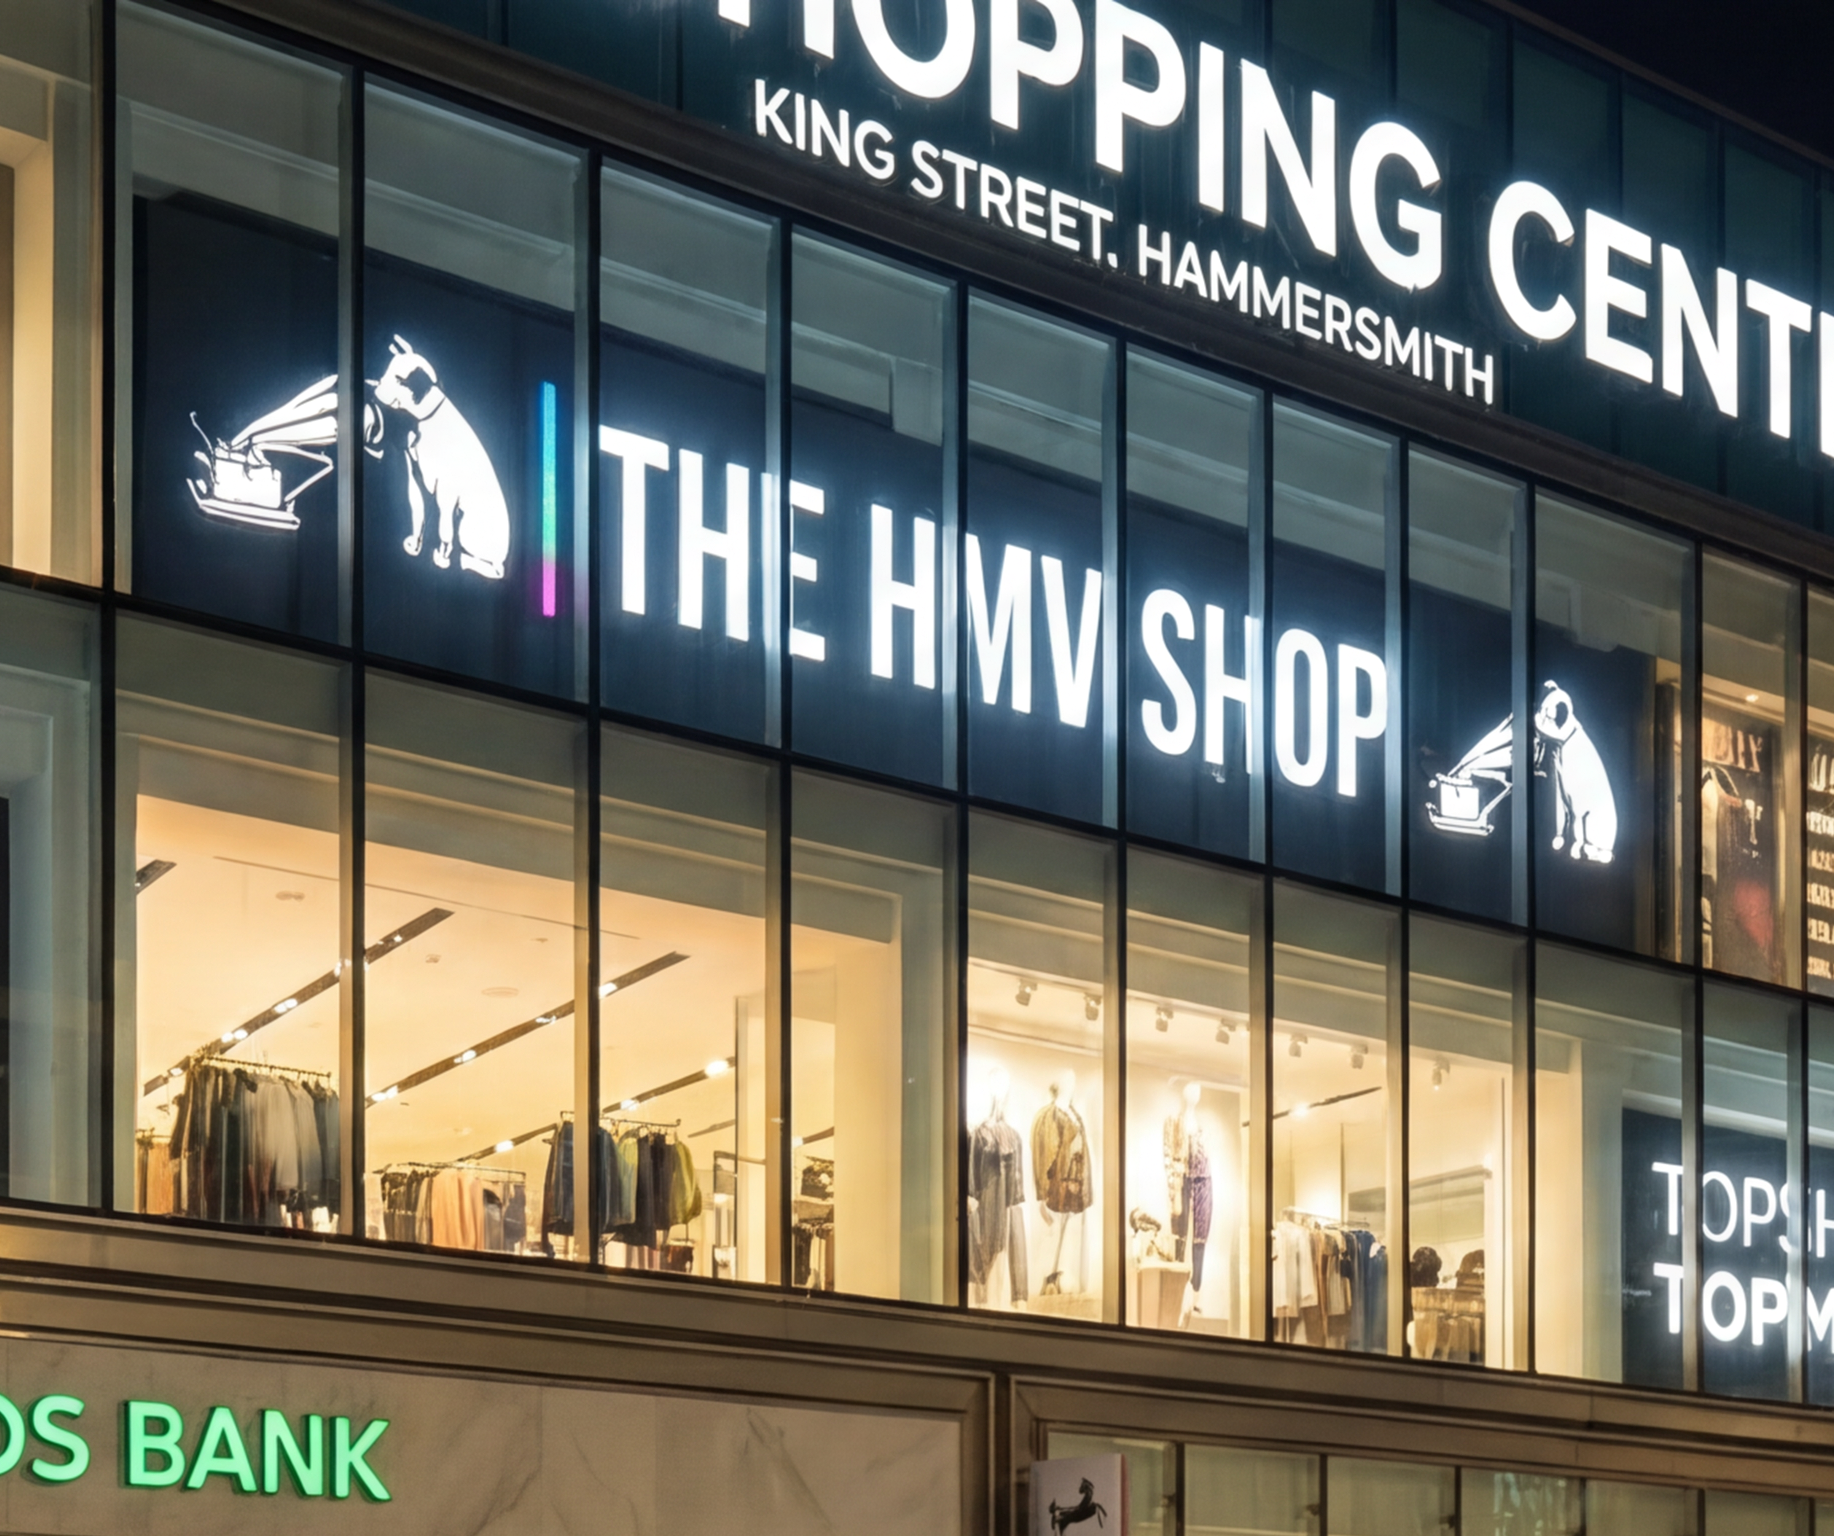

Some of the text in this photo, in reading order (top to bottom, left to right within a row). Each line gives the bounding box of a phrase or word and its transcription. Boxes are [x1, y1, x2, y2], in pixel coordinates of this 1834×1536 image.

[718, 0, 1442, 291] OPPING
[755, 79, 896, 180] KING
[1138, 224, 1493, 405] HAMMERSMITH
[599, 424, 1389, 797] THE HMV SHOP
[124, 1399, 392, 1502] BANK
